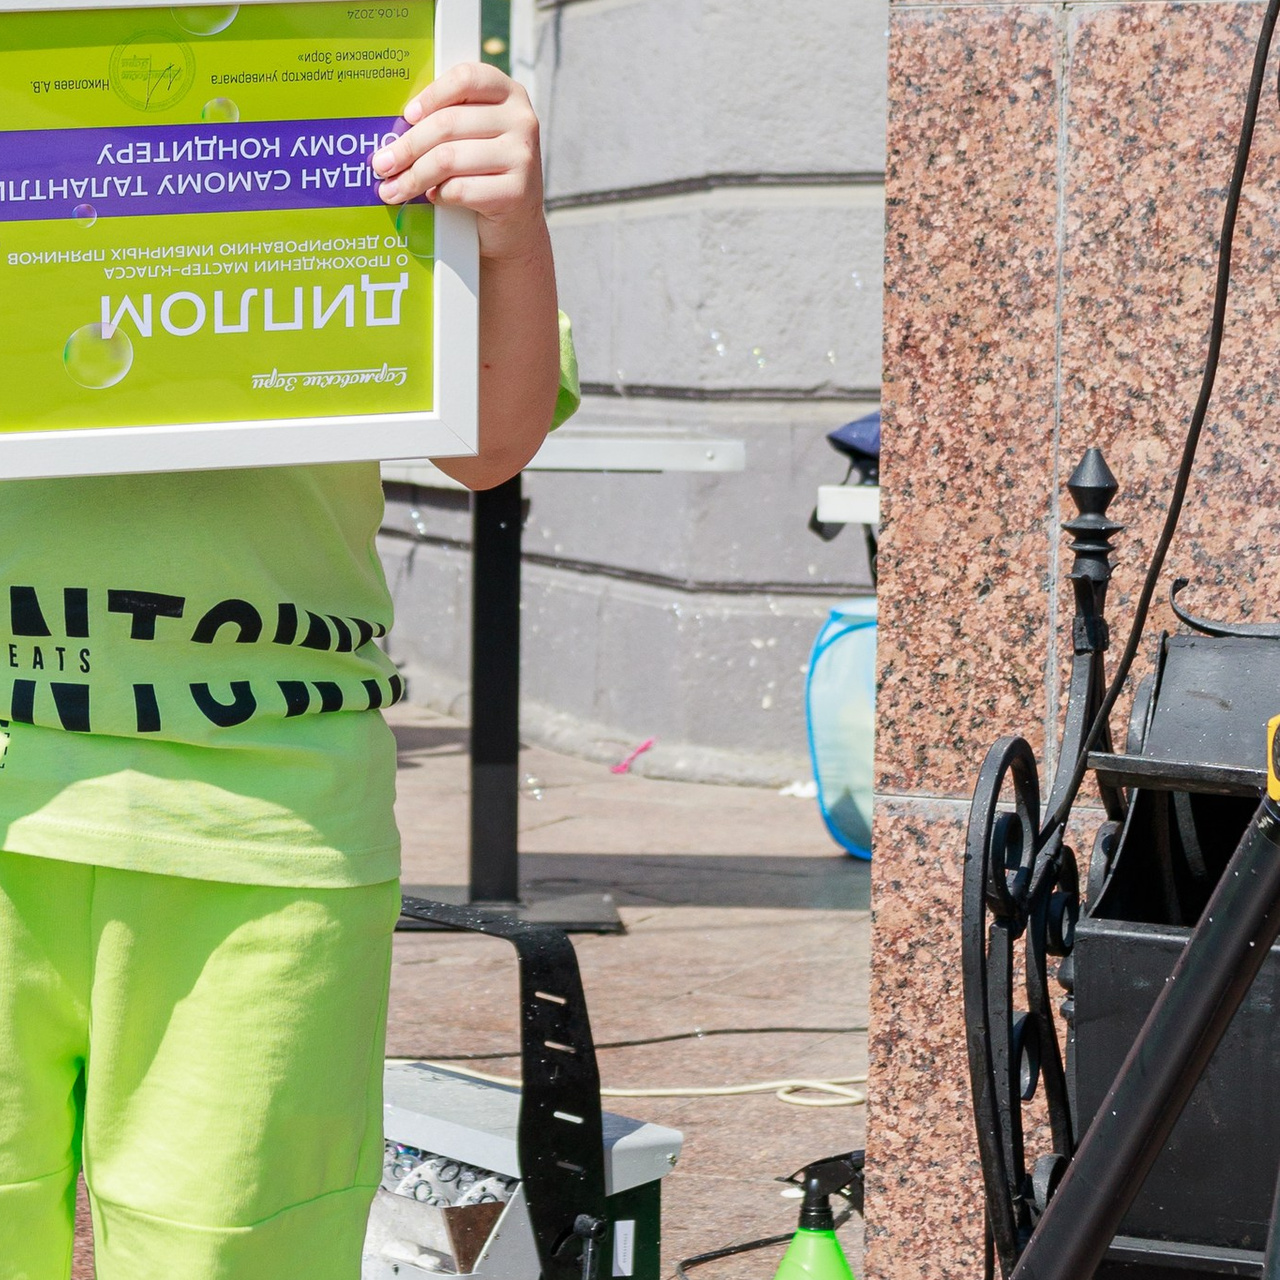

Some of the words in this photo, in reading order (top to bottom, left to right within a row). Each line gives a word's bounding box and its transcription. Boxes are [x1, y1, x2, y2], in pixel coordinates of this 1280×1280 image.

[346, 8, 409, 20] 01.06.2024
[297, 50, 332, 64] Зори»
[336, 48, 410, 63] «Сормовские
[210, 70, 278, 86] универмага
[282, 68, 334, 84] директор
[337, 66, 410, 82] Генеральный
[30, 80, 51, 94] А.В.
[54, 79, 110, 92] Николаев
[96, 135, 280, 165] КОНДИТЕРУ
[156, 169, 292, 196] САМОМУ
[301, 162, 382, 189] ЫДАН
[219, 234, 380, 255] ДЕКОРИРОВАНИЮ
[384, 236, 408, 248] ПО
[7, 249, 106, 265] ПРЯНИКОВ
[110, 244, 214, 260] ИМБИРНЫХ
[396, 254, 408, 266] О
[103, 261, 248, 280] МАСТЕР-КЛАССА
[254, 255, 390, 274] ПРОХОЖДЕНИИ
[100, 272, 409, 340] ДИПЛОМ
[252, 368, 298, 392] Зори
[302, 362, 408, 388] Сормовские
